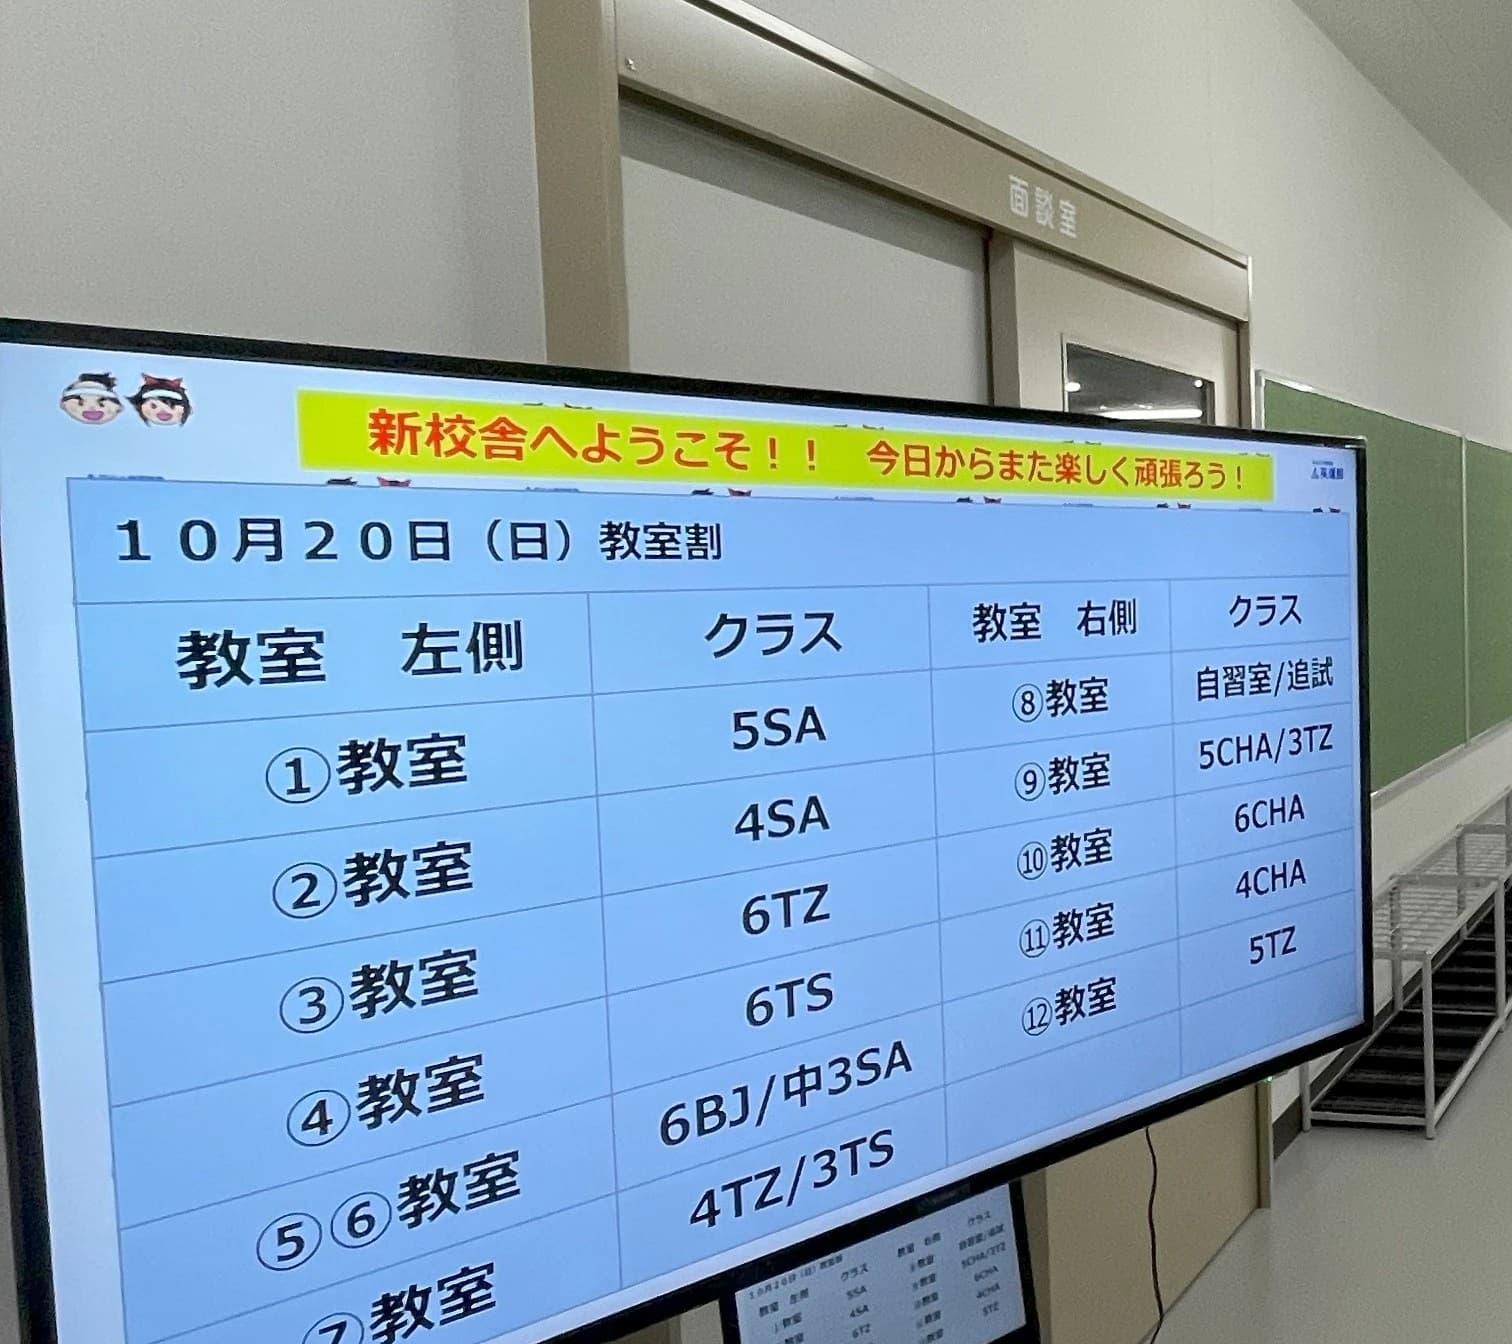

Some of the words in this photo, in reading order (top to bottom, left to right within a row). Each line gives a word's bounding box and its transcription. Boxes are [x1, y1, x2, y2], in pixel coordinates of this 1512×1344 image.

[1008, 174, 1077, 238] 面談室
[368, 407, 817, 471] 新校舎へようこそ！！
[866, 440, 1245, 490] 今日からまた楽しく頑張ろう！
[704, 612, 842, 659] クラス
[972, 601, 1042, 643] 教室
[1076, 598, 1137, 637] 右側
[1229, 594, 1302, 628] クラス
[176, 627, 326, 690] 教室
[401, 620, 523, 676] 左側
[1197, 656, 1334, 702] 自習室/追試
[1011, 676, 1109, 723] ⑧教室
[732, 705, 827, 750] 5SA
[1199, 723, 1333, 770] 5CHA/3TZ
[265, 732, 468, 804] ①教室
[1014, 751, 1111, 802] ⑨教室
[734, 795, 830, 842] 4SA
[1234, 793, 1305, 833] 6CHA
[272, 840, 473, 919] ②教室
[1016, 827, 1113, 881] ⑩教室
[1235, 858, 1307, 899] 4CHA
[742, 883, 831, 935] 6TZ
[1019, 902, 1115, 959] ⑪教室
[1250, 925, 1297, 965] 5TZ
[279, 948, 479, 1034] ③教室
[746, 972, 833, 1027] 6TS
[1021, 976, 1117, 1037] ⑫教室
[286, 1053, 485, 1147] ④教室
[660, 1040, 913, 1146] 6BJ/中3SA
[689, 1129, 895, 1229] 4TZ/3TS
[256, 1150, 521, 1271] ⑤⑥教室
